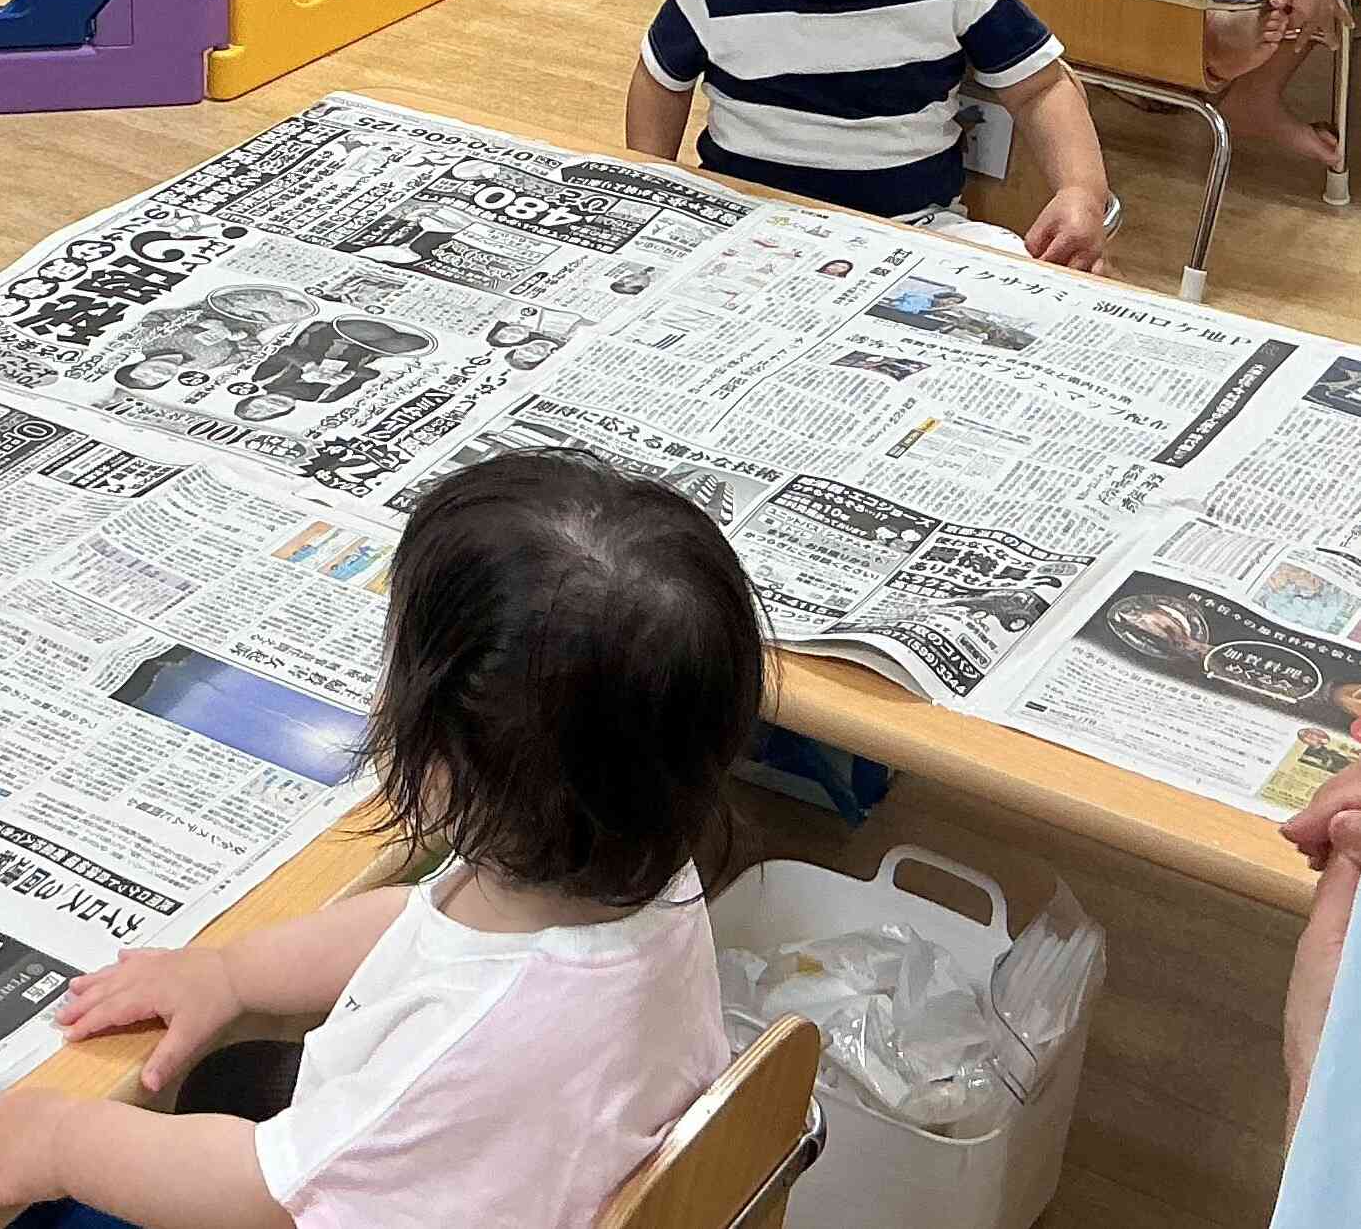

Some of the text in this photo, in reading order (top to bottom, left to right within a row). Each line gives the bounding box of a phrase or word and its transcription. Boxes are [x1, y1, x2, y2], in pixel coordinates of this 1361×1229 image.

[351, 114, 536, 162] 0120-606-125
[527, 396, 788, 486] 期待に応える確かな技術
